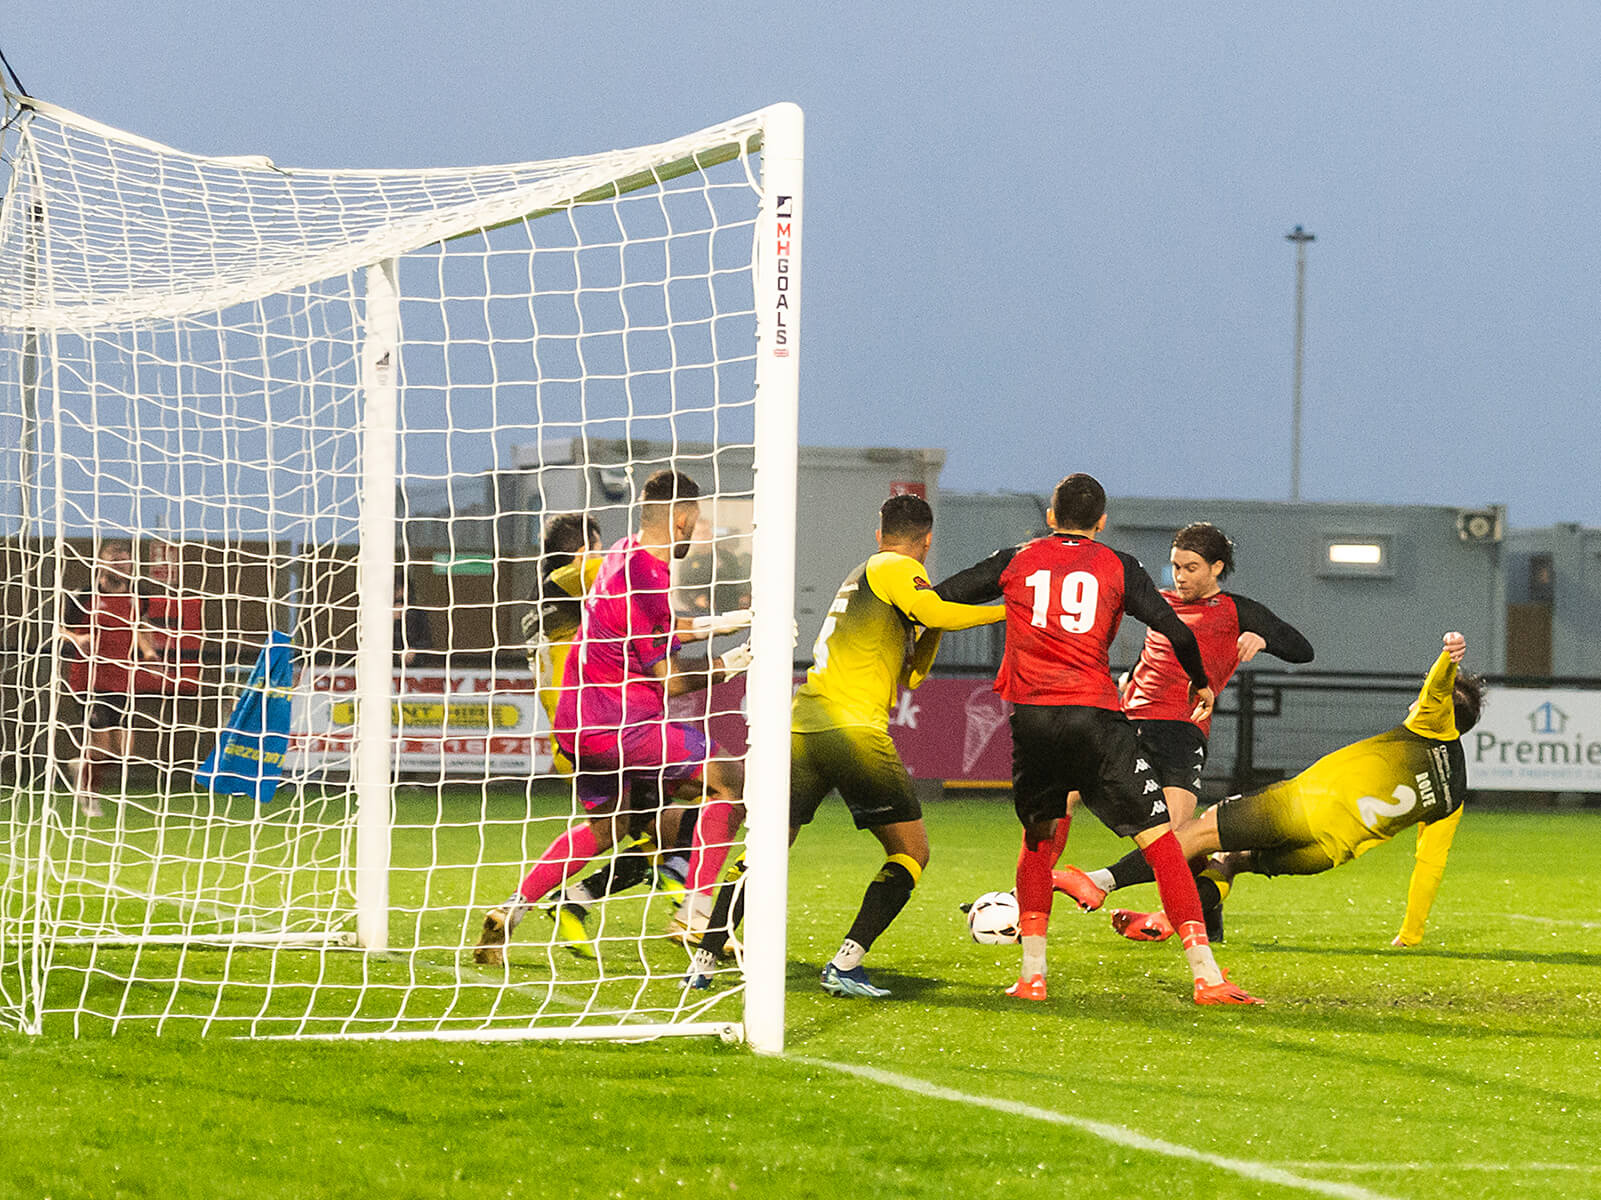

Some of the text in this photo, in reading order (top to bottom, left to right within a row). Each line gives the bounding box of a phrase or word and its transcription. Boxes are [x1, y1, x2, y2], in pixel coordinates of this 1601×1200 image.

[1025, 569, 1099, 634] 19
[1356, 784, 1417, 829] 2
[1415, 771, 1437, 808] ROLFE
